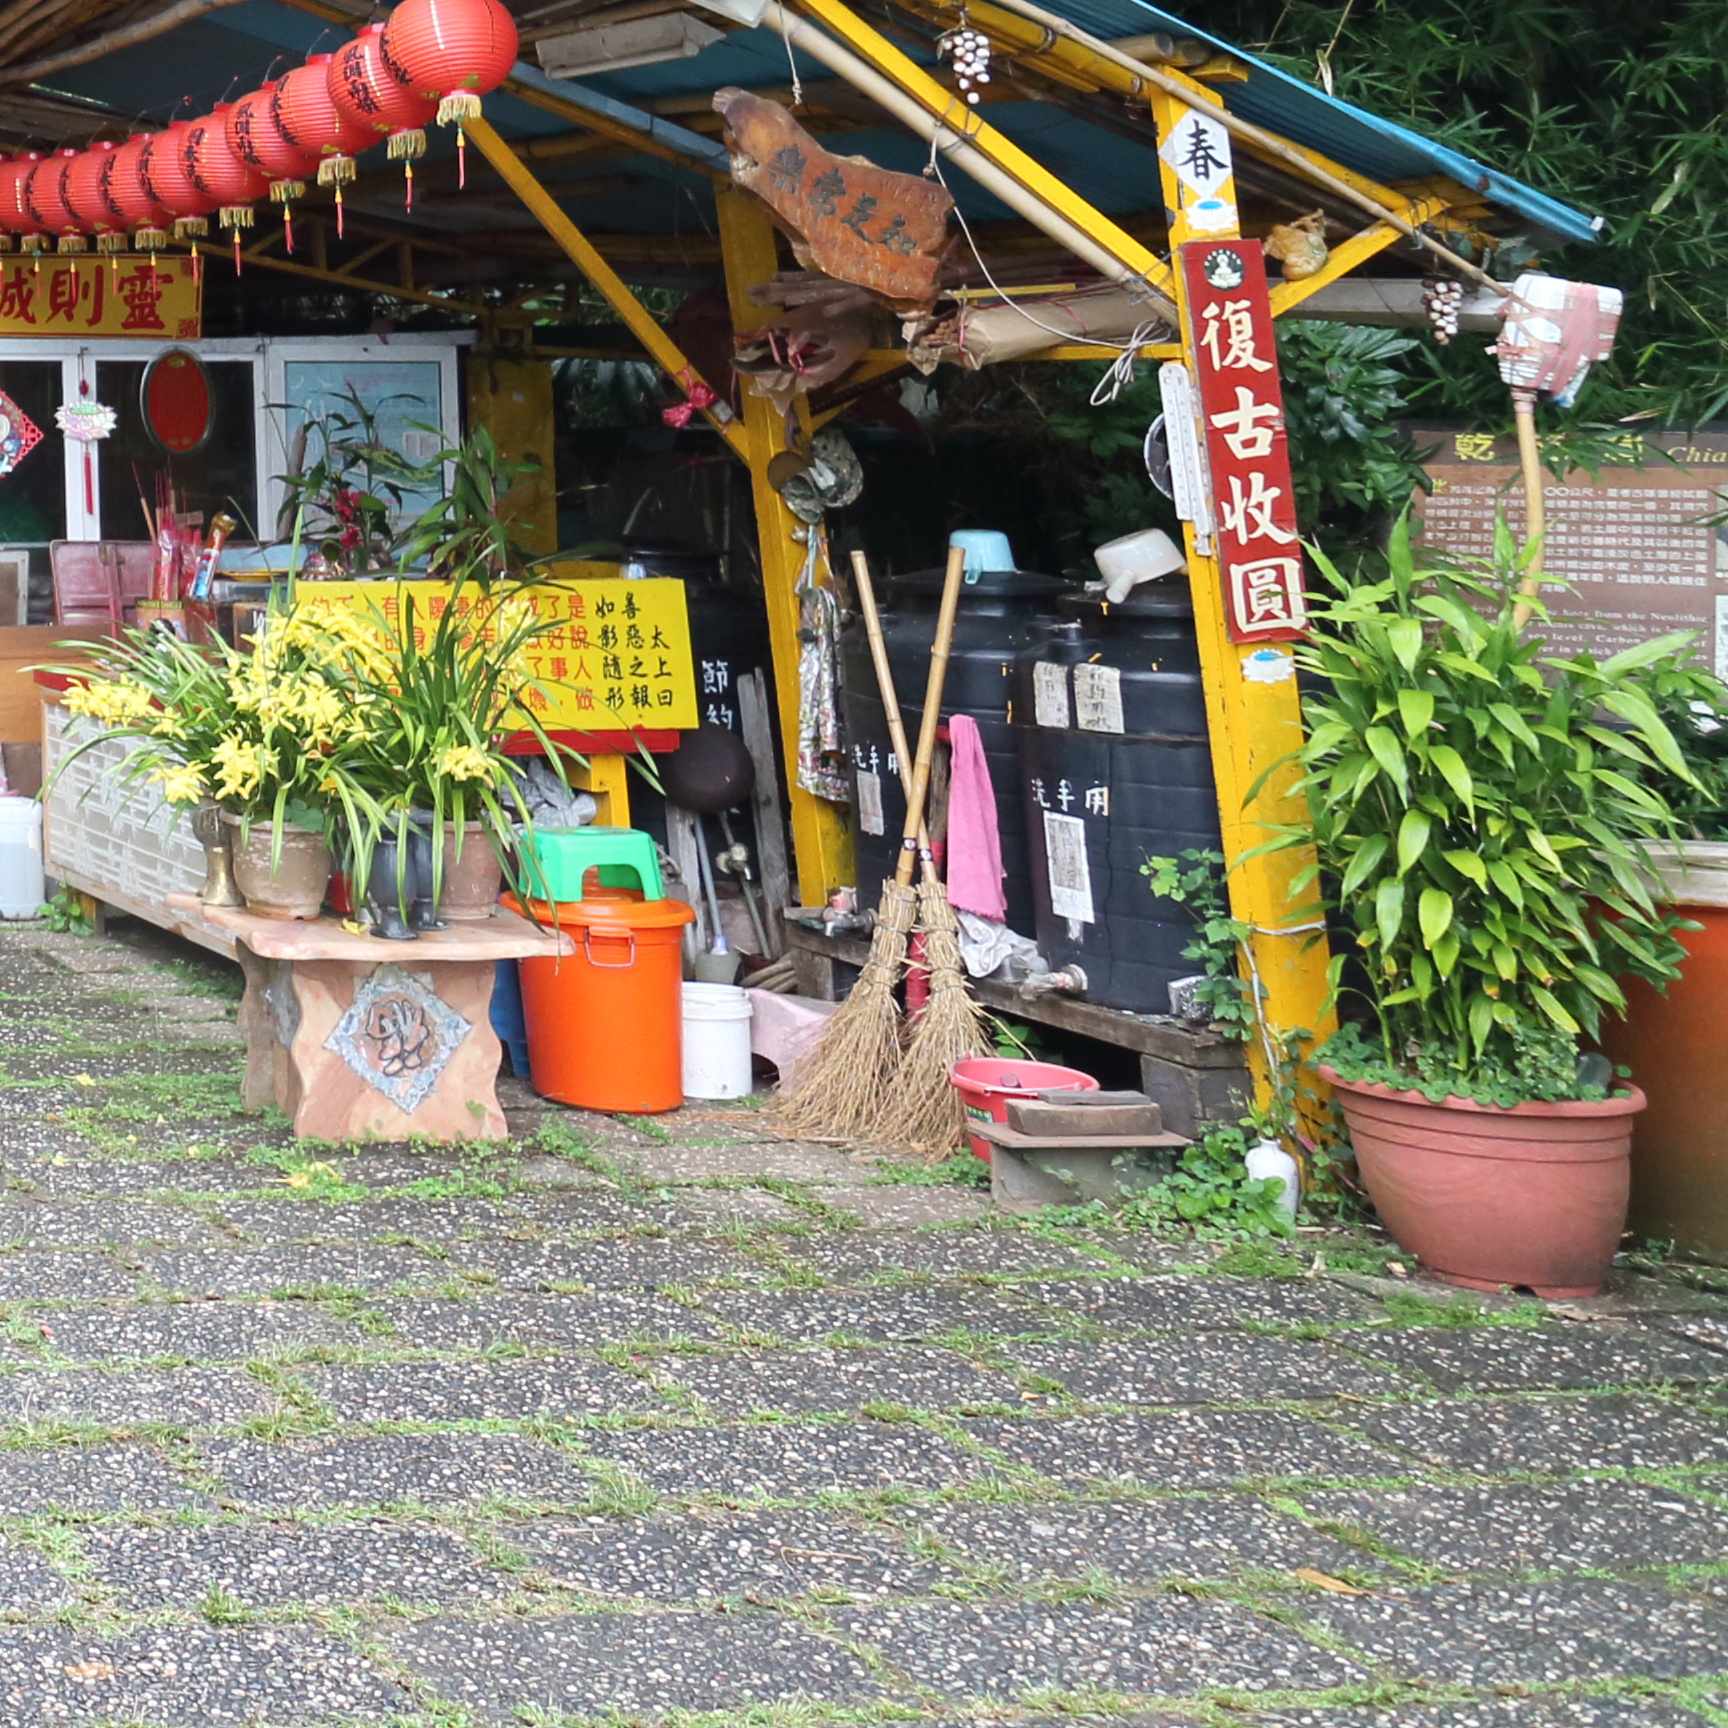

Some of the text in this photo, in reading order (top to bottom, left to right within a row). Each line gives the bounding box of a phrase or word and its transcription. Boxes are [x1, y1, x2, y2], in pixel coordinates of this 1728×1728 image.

[1176, 120, 1230, 179] 春
[1198, 299, 1309, 635] 復古收圓
[567, 594, 595, 712] 是說人做
[595, 594, 625, 711] 如影隨形
[621, 592, 653, 709] 善惡之報
[1594, 610, 1622, 619] from
[1627, 612, 1645, 620] the
[1650, 612, 1708, 623] Neolithic
[1595, 634, 1641, 644] Carbon
[1692, 639, 1707, 648] of
[651, 625, 674, 708] 太上曰
[702, 659, 733, 730] 節約
[1030, 777, 1109, 817] 洗手用
